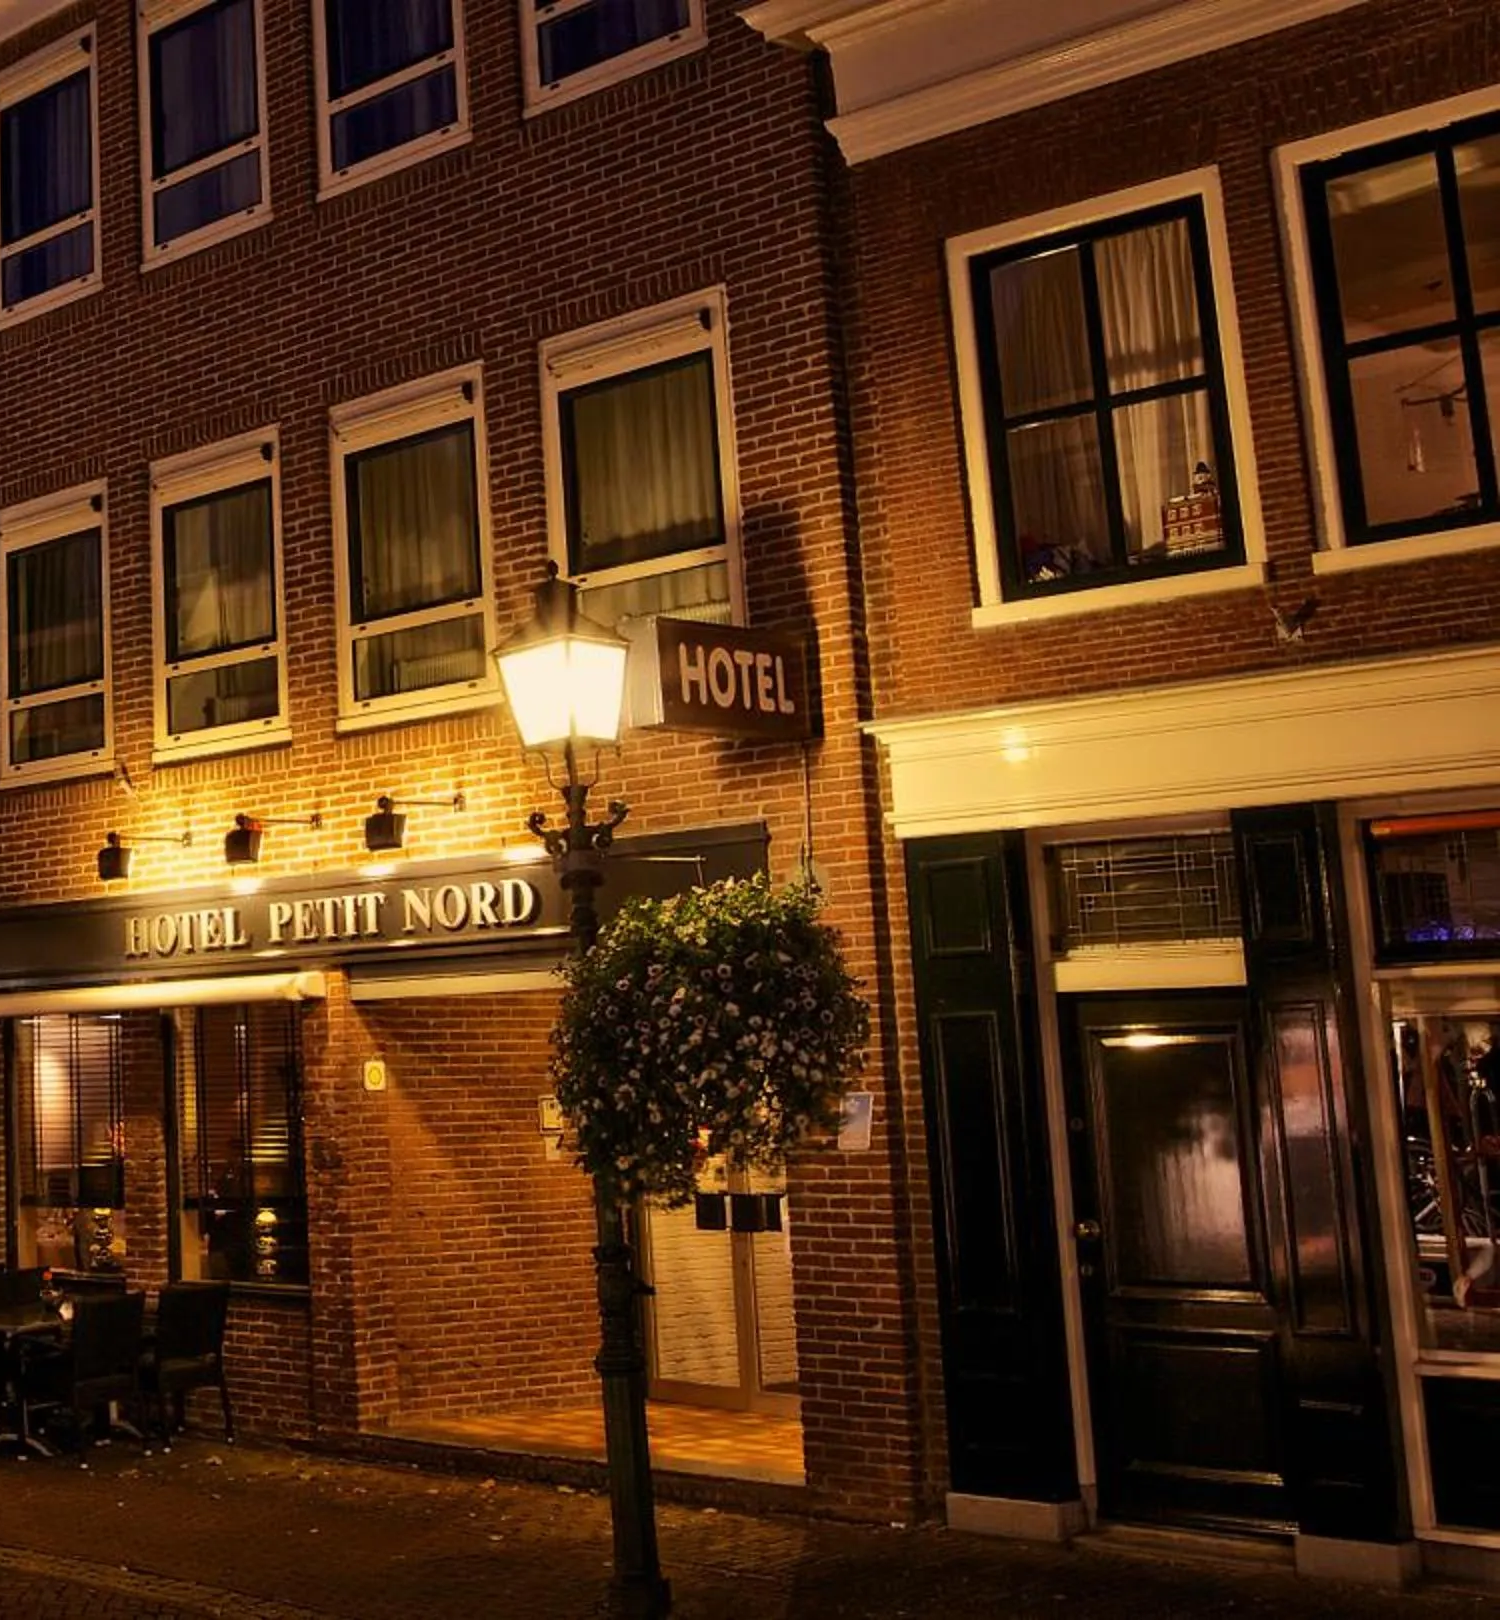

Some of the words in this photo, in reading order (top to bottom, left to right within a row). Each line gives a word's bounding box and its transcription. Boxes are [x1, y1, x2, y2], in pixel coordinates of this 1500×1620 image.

[679, 641, 796, 714] HOTEL
[125, 906, 246, 957] HOTEL
[267, 892, 386, 945] PETIT
[402, 877, 536, 932] NORD
